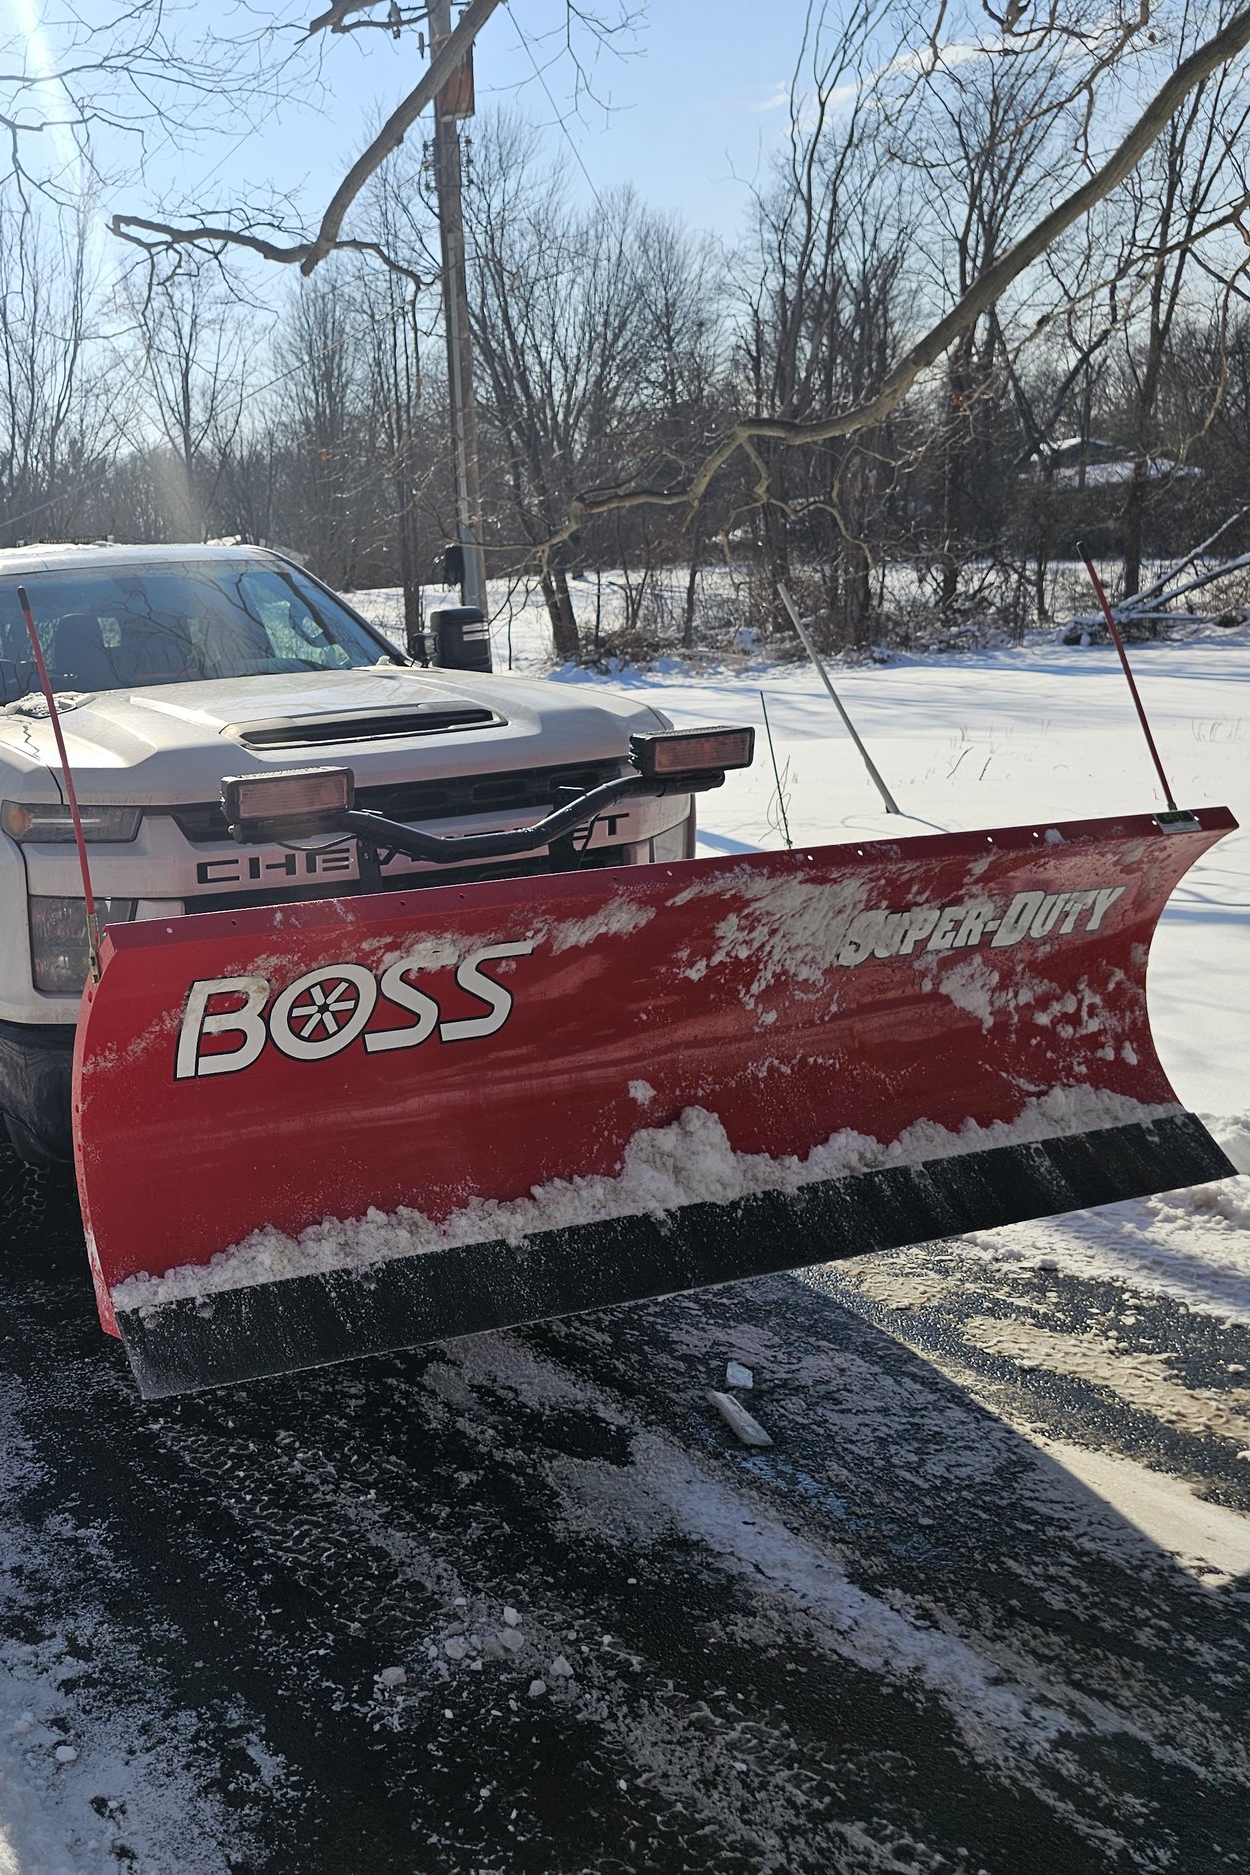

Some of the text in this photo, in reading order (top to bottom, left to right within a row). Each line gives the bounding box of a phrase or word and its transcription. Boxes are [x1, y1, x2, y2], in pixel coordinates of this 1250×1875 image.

[197, 812, 630, 884] CHEVT
[836, 886, 1127, 967] SUPER-DUTY
[173, 940, 535, 1082] BOSS
